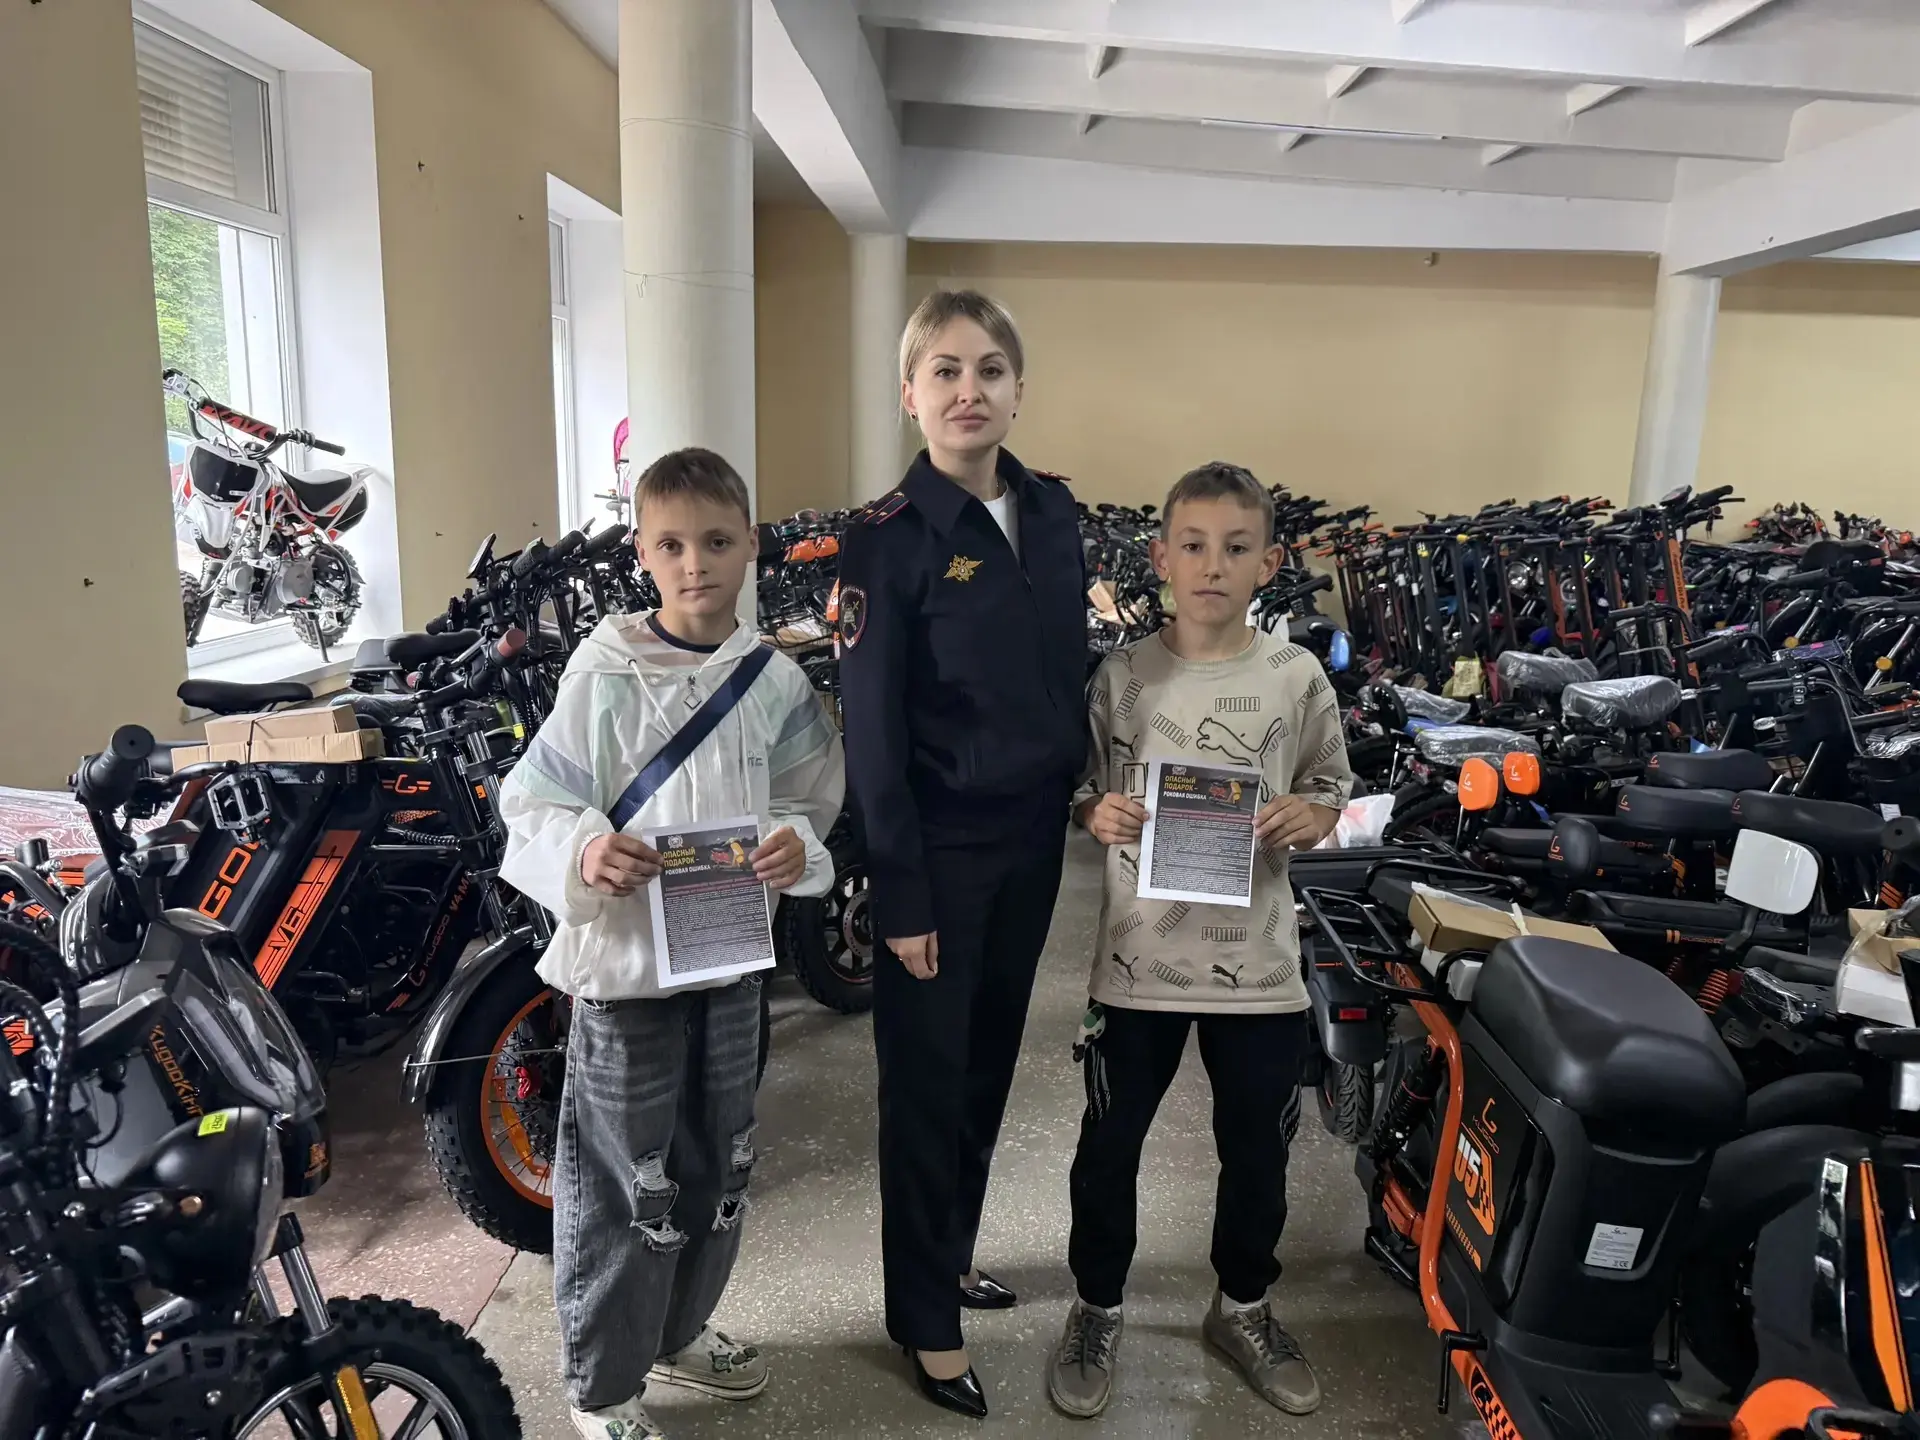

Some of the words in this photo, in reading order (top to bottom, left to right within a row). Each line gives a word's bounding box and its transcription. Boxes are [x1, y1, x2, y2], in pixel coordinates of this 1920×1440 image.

[1114, 678, 1144, 721] PUMA
[1215, 697, 1260, 712] PUMA
[1150, 712, 1192, 749] PUMA
[1164, 775, 1196, 784] ОПАСНЫЙ
[1164, 783, 1194, 791] ПОДАРОК
[663, 847, 696, 859] ОПАСНЫЙ
[664, 857, 695, 867] ПОДАРОК
[665, 867, 688, 876] РОКОВАЯ
[688, 865, 711, 873] ОШИБКА
[268, 906, 303, 950] V6
[1109, 911, 1144, 941] PUMA
[1202, 926, 1247, 941] PUMA
[1148, 959, 1194, 990] PUMA
[1256, 960, 1296, 992] PUMA
[1453, 1132, 1482, 1198] U5
